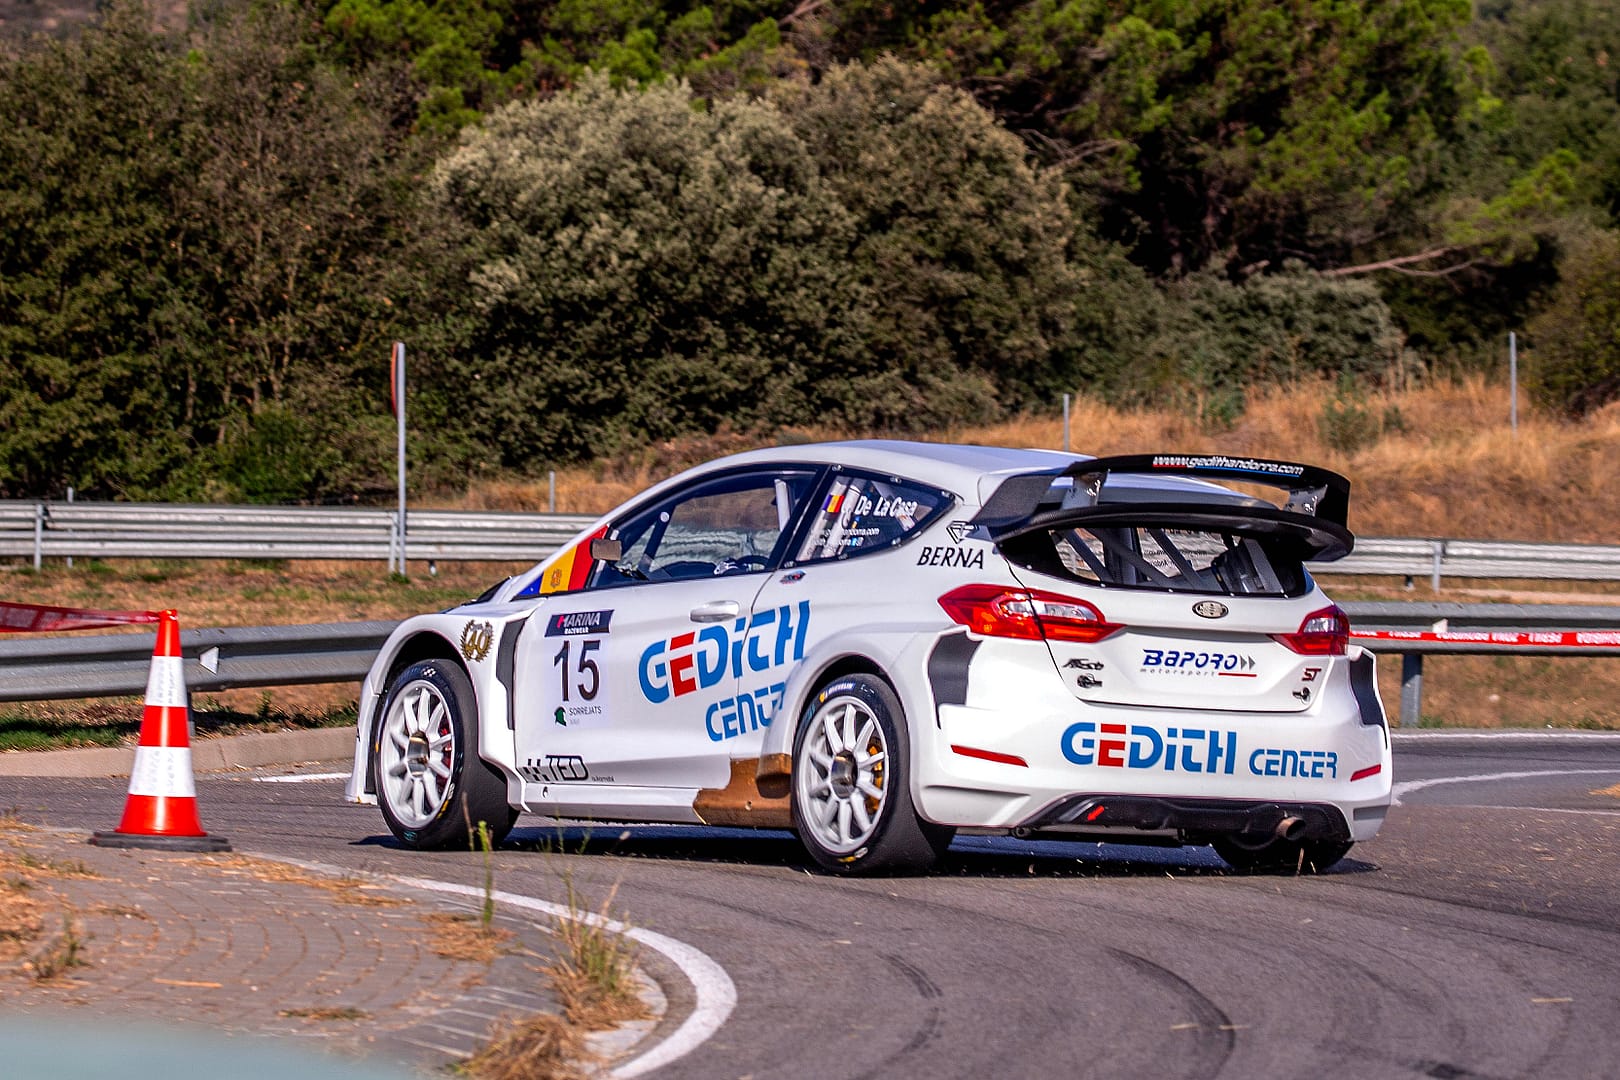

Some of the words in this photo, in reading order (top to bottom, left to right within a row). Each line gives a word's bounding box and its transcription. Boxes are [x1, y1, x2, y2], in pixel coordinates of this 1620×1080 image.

[1152, 455, 1304, 476] www.gedithandorra.com
[855, 495, 872, 516] De
[873, 496, 891, 517] La
[890, 496, 918, 518] Casa
[917, 546, 985, 570] BERNA
[557, 612, 600, 629] MARINA
[553, 639, 601, 702] 15
[1139, 667, 1217, 677] motorsport
[1301, 667, 1322, 682] ST
[1248, 748, 1339, 779] CENTER
